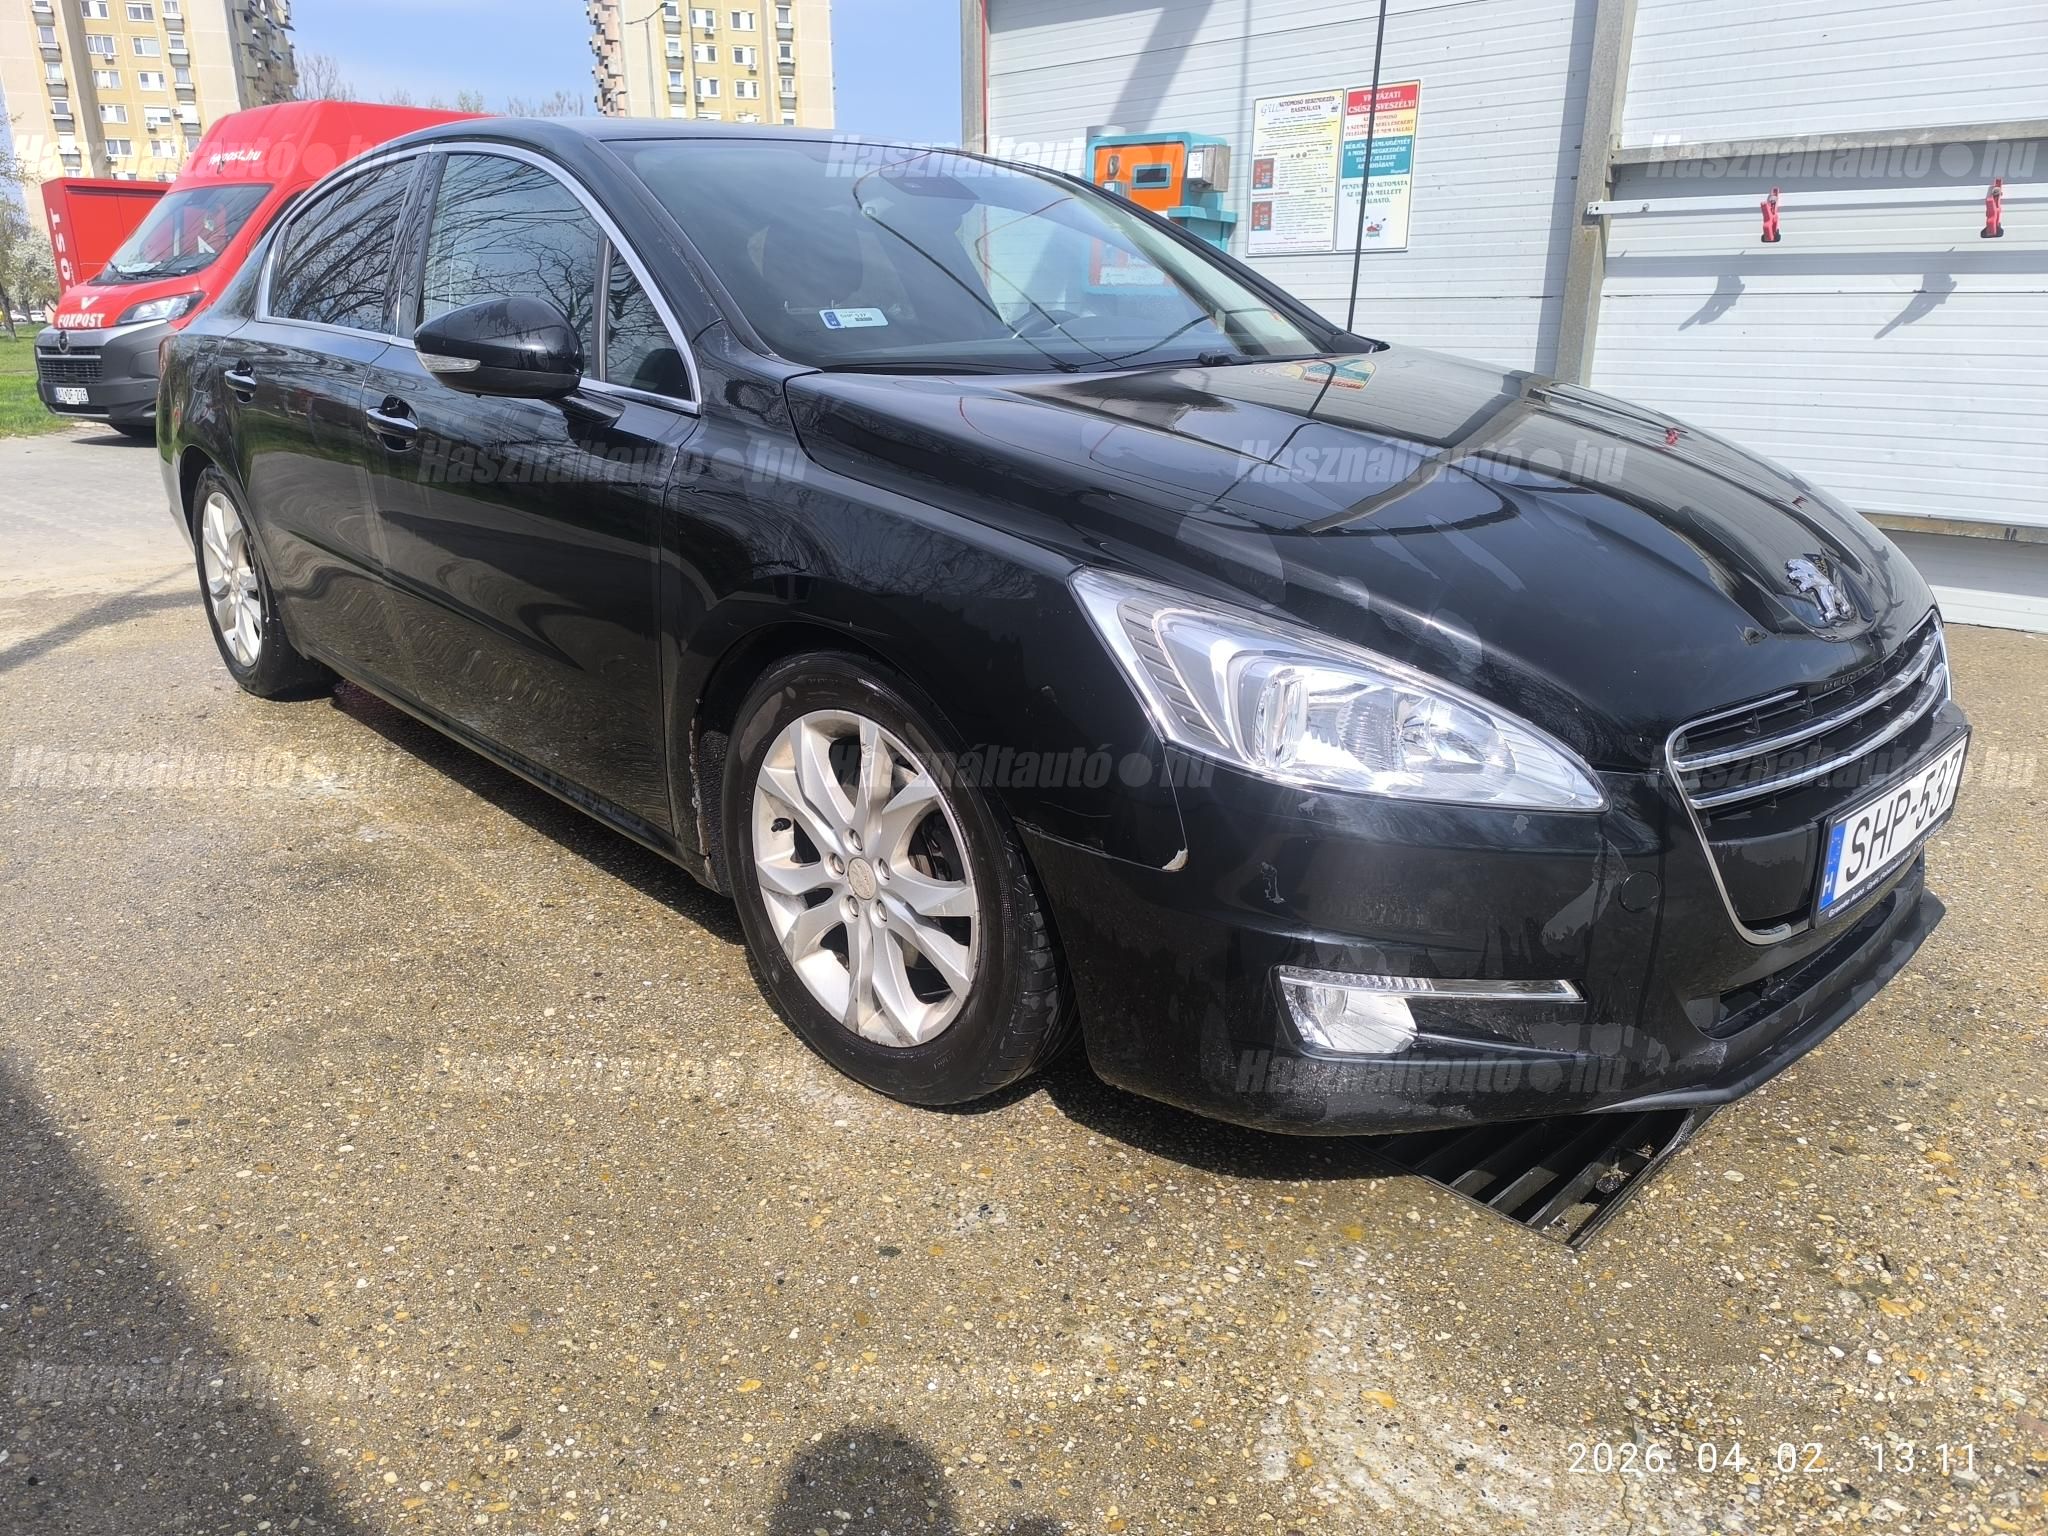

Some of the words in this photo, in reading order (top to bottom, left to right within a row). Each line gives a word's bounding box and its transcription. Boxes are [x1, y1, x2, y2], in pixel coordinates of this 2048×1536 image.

[1348, 99, 1415, 113] CSÚSZSVESZÉLY!
[58, 313, 105, 328] FOXPOST
[1845, 747, 1962, 883] SHP-537
